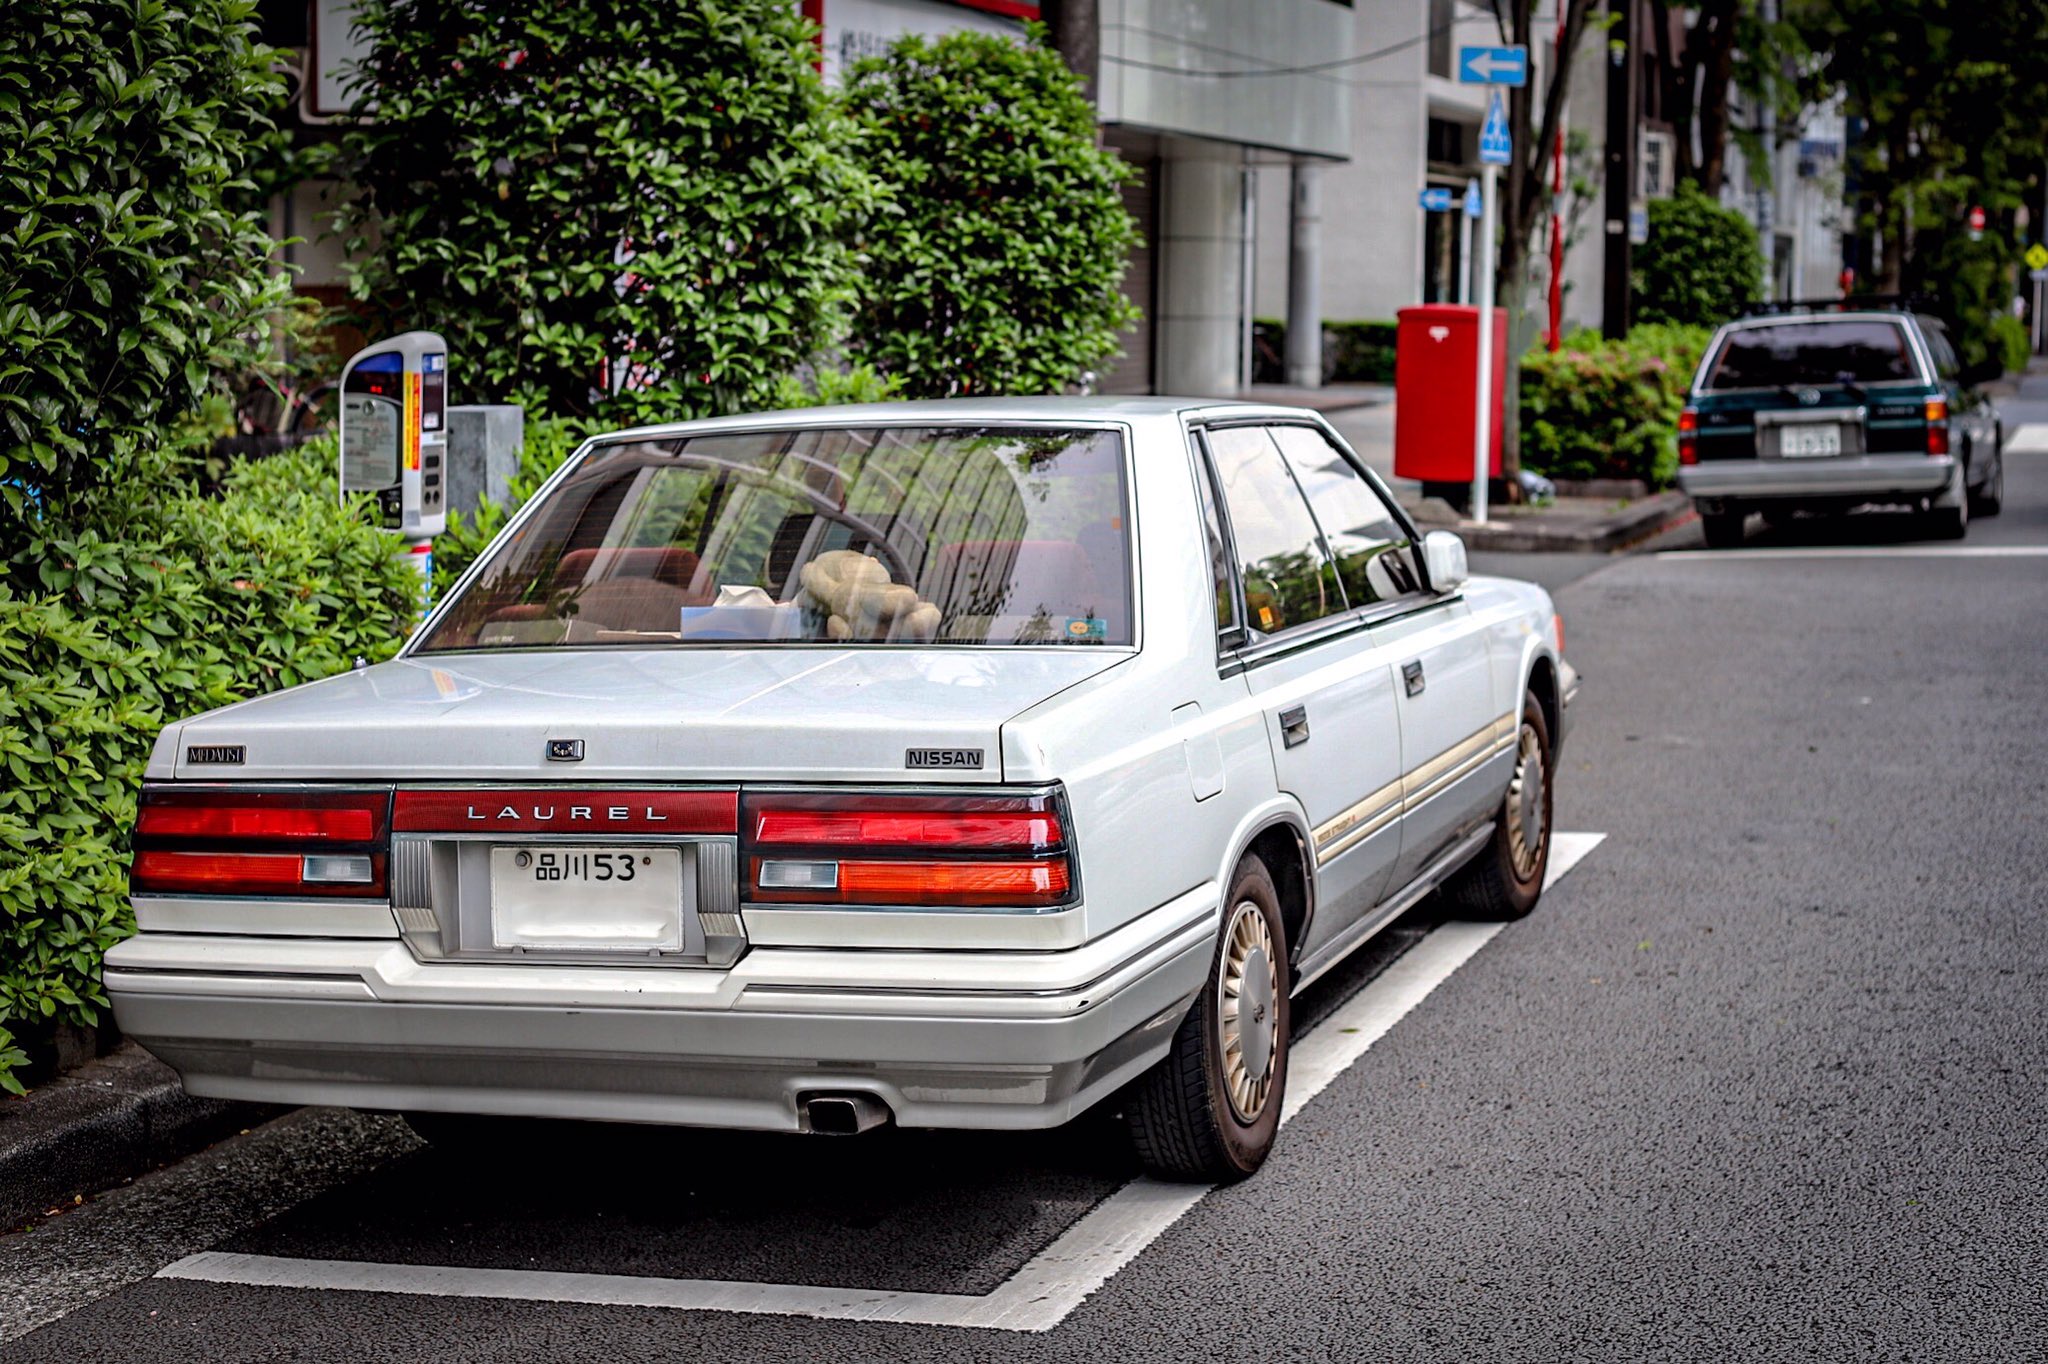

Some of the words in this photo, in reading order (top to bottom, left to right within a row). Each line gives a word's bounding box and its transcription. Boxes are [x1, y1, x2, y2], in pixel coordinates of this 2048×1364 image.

[909, 751, 980, 765] NISSAN
[468, 806, 668, 820] LAUREL
[536, 853, 636, 882] 品川53
